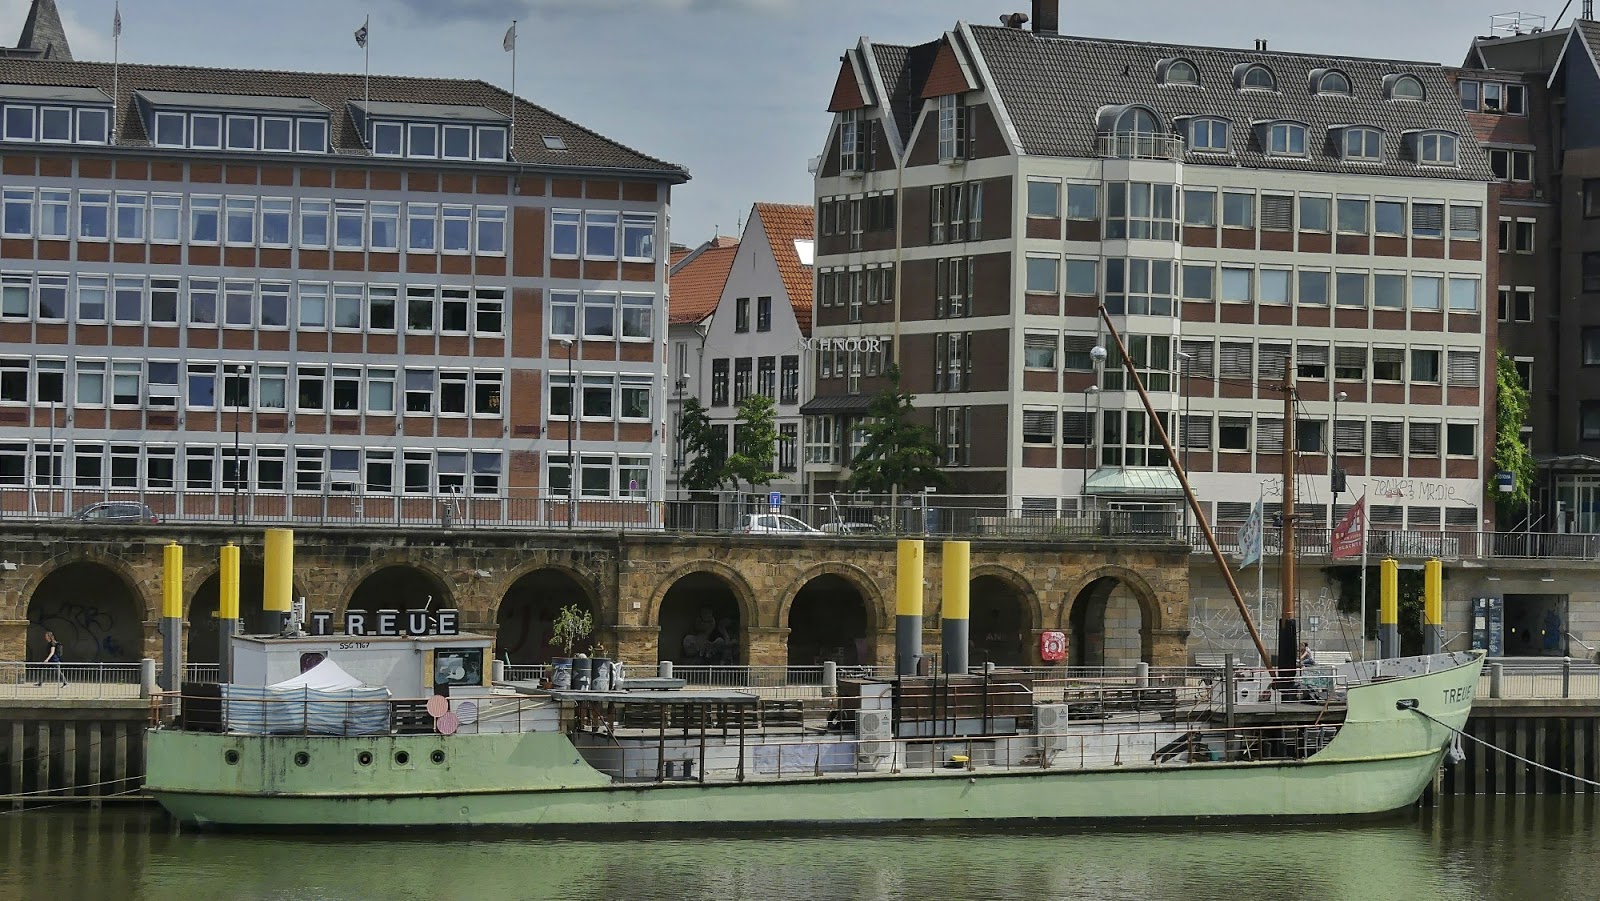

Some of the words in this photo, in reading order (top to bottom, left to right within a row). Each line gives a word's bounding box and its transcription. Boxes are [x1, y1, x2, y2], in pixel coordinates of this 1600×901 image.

[798, 338, 881, 353] SCHNOOR
[313, 613, 456, 635] TREUE
[1443, 685, 1472, 704] TREUE
